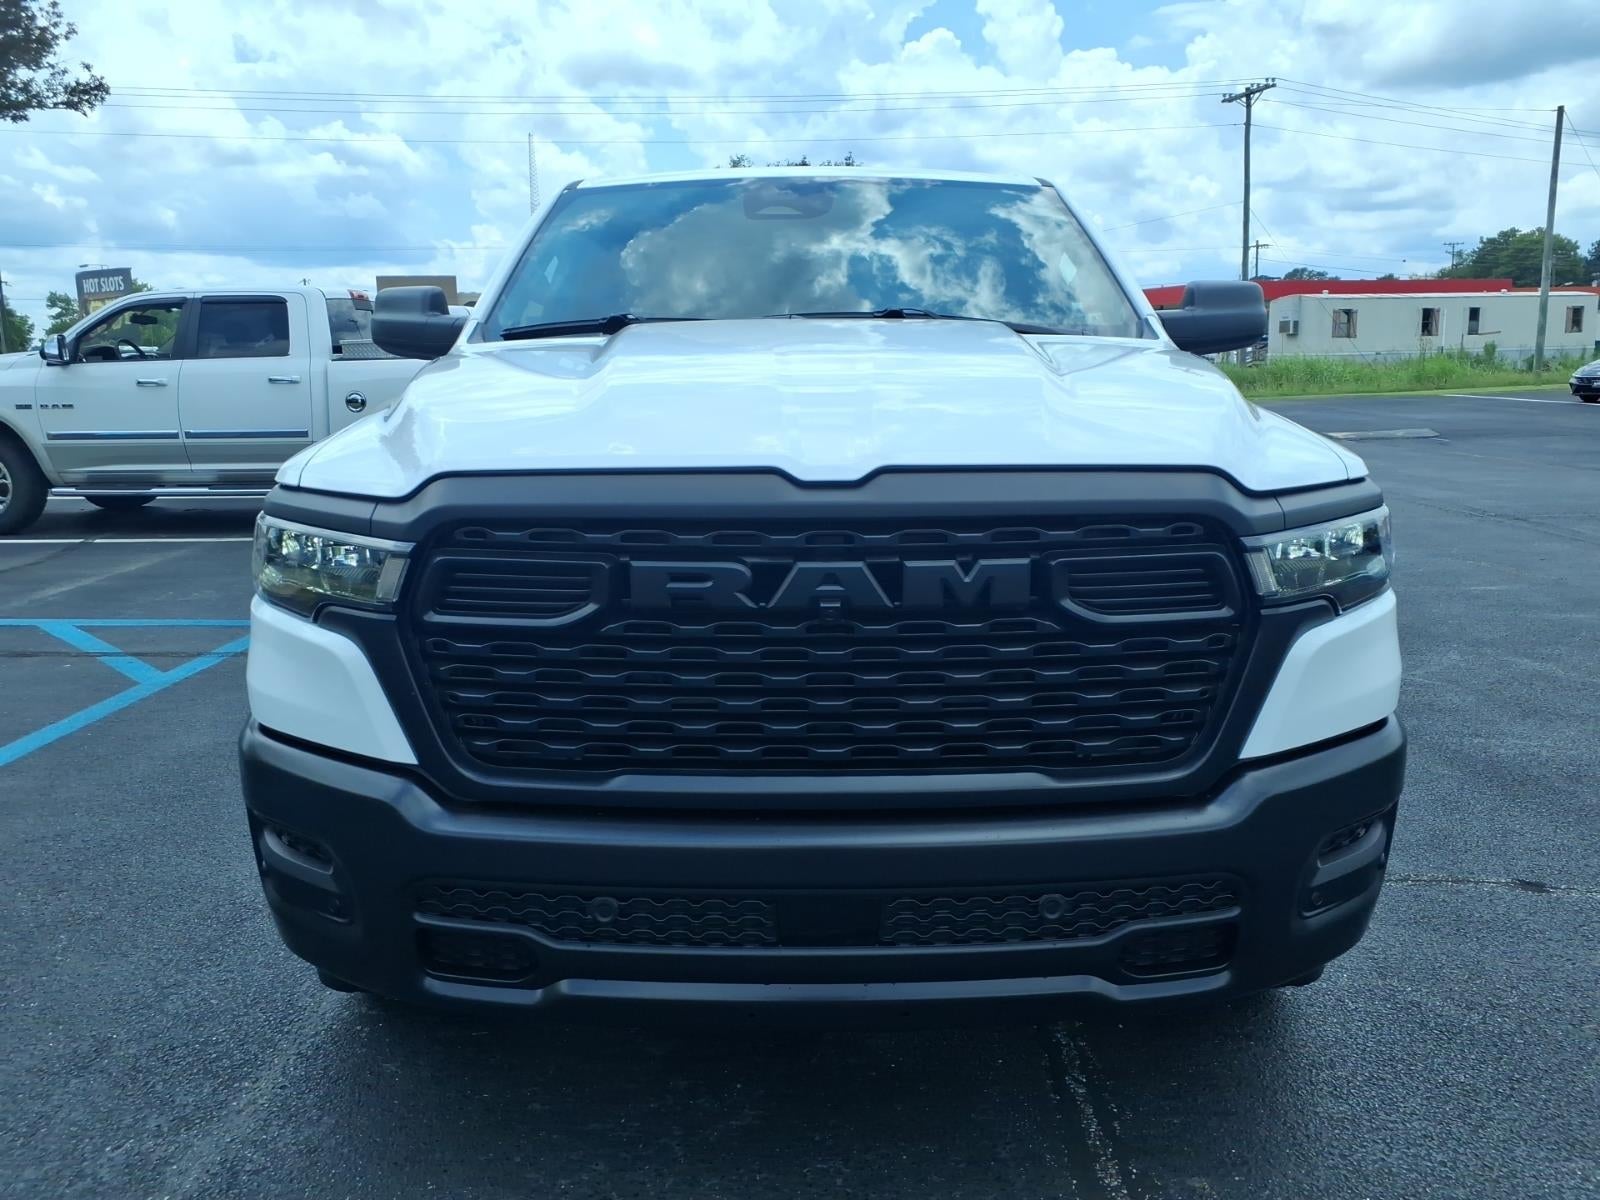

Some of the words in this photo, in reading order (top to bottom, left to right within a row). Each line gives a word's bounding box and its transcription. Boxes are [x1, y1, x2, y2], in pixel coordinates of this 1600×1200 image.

[83, 278, 99, 293] HOT
[100, 275, 124, 292] SLOTS
[629, 559, 1031, 609] RAM
